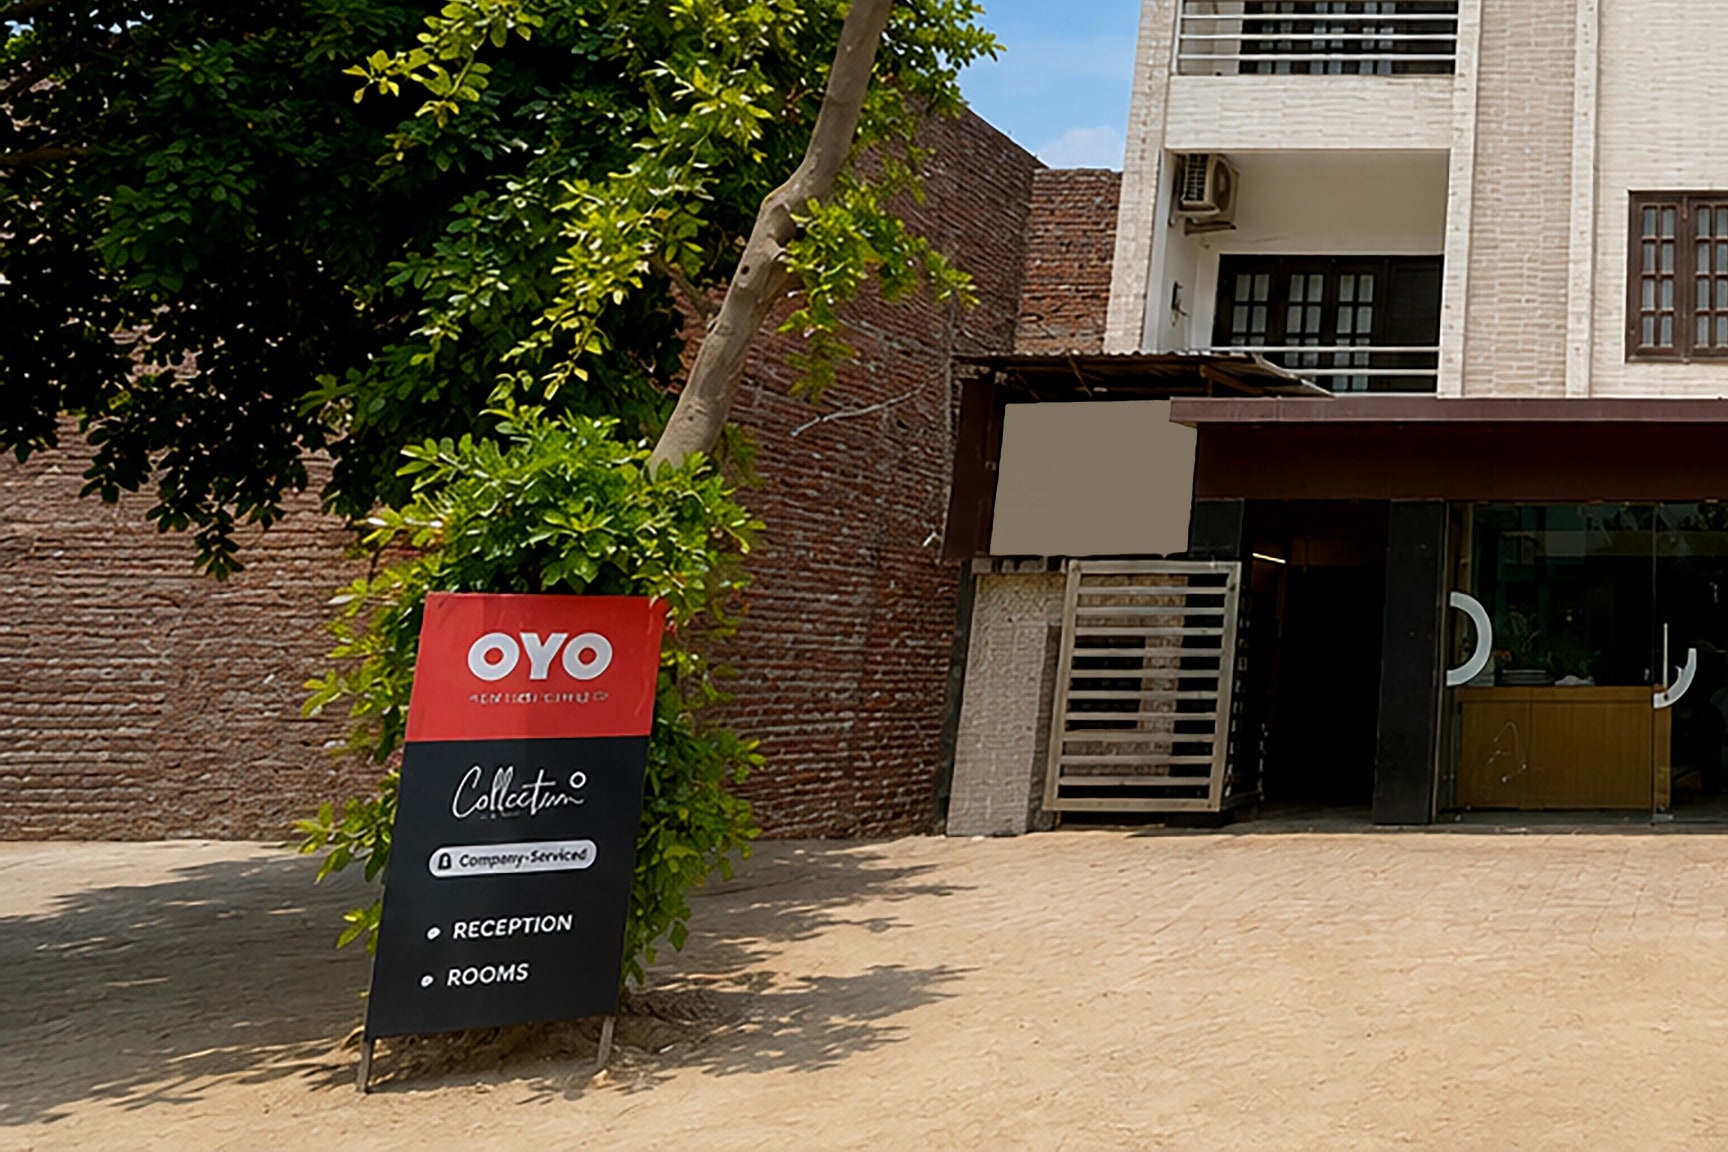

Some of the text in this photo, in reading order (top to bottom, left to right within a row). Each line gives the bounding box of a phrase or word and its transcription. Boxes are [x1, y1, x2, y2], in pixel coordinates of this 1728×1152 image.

[467, 632, 614, 681] OYO
[452, 914, 574, 940] RECEPTION
[446, 963, 530, 987] ROOMS
